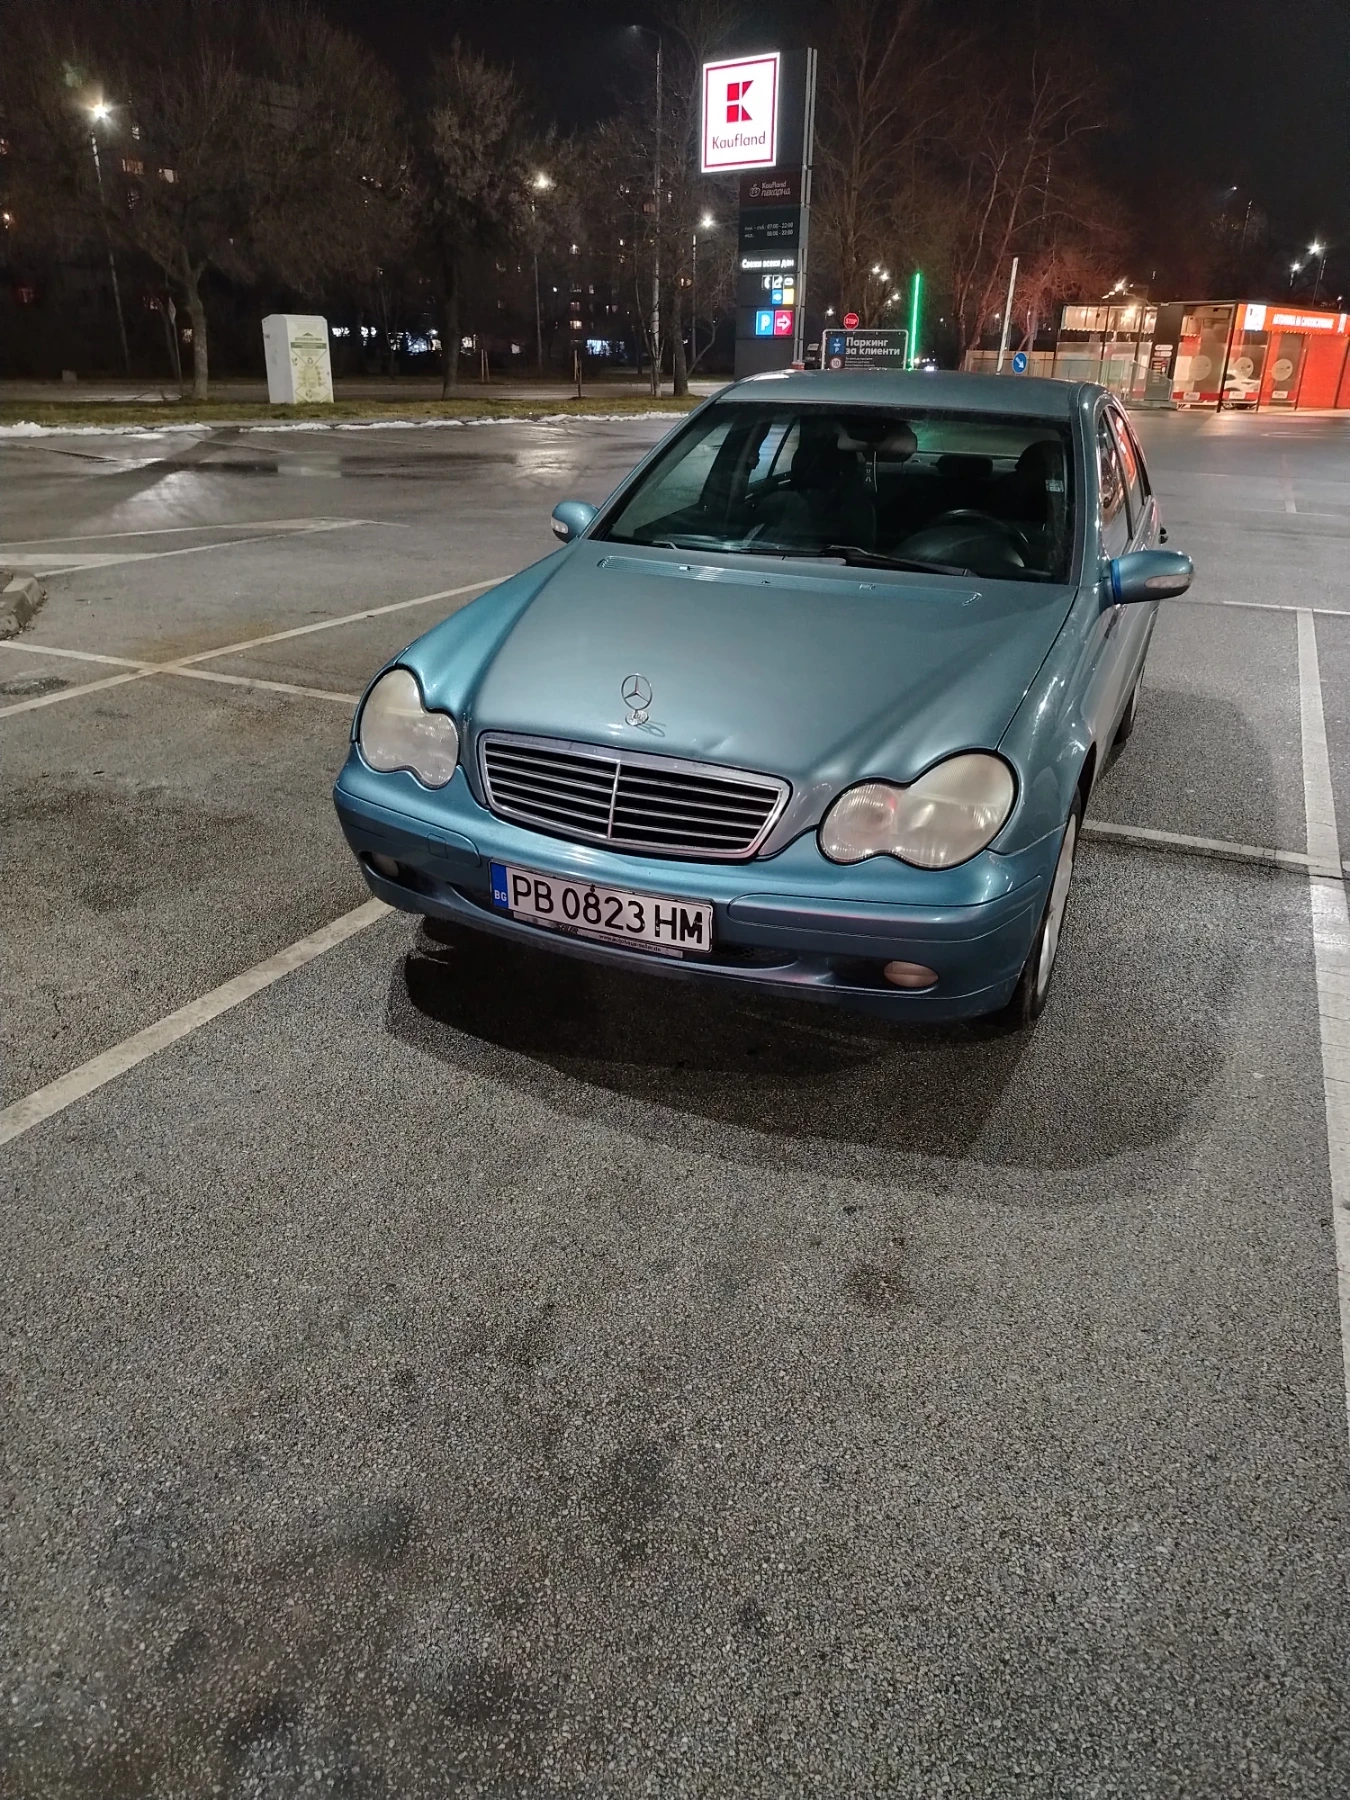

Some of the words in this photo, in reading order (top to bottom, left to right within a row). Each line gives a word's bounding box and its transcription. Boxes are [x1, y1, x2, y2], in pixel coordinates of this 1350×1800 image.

[712, 131, 766, 150] Kaufland
[761, 181, 787, 189] Kaufland
[761, 314, 770, 331] P
[845, 317, 858, 325] STOP
[846, 337, 888, 348] Паркинг
[859, 348, 900, 356] клиенти
[494, 889, 507, 902] BG
[512, 874, 554, 913] PB
[562, 888, 645, 933] 0823
[654, 904, 703, 944] HM
